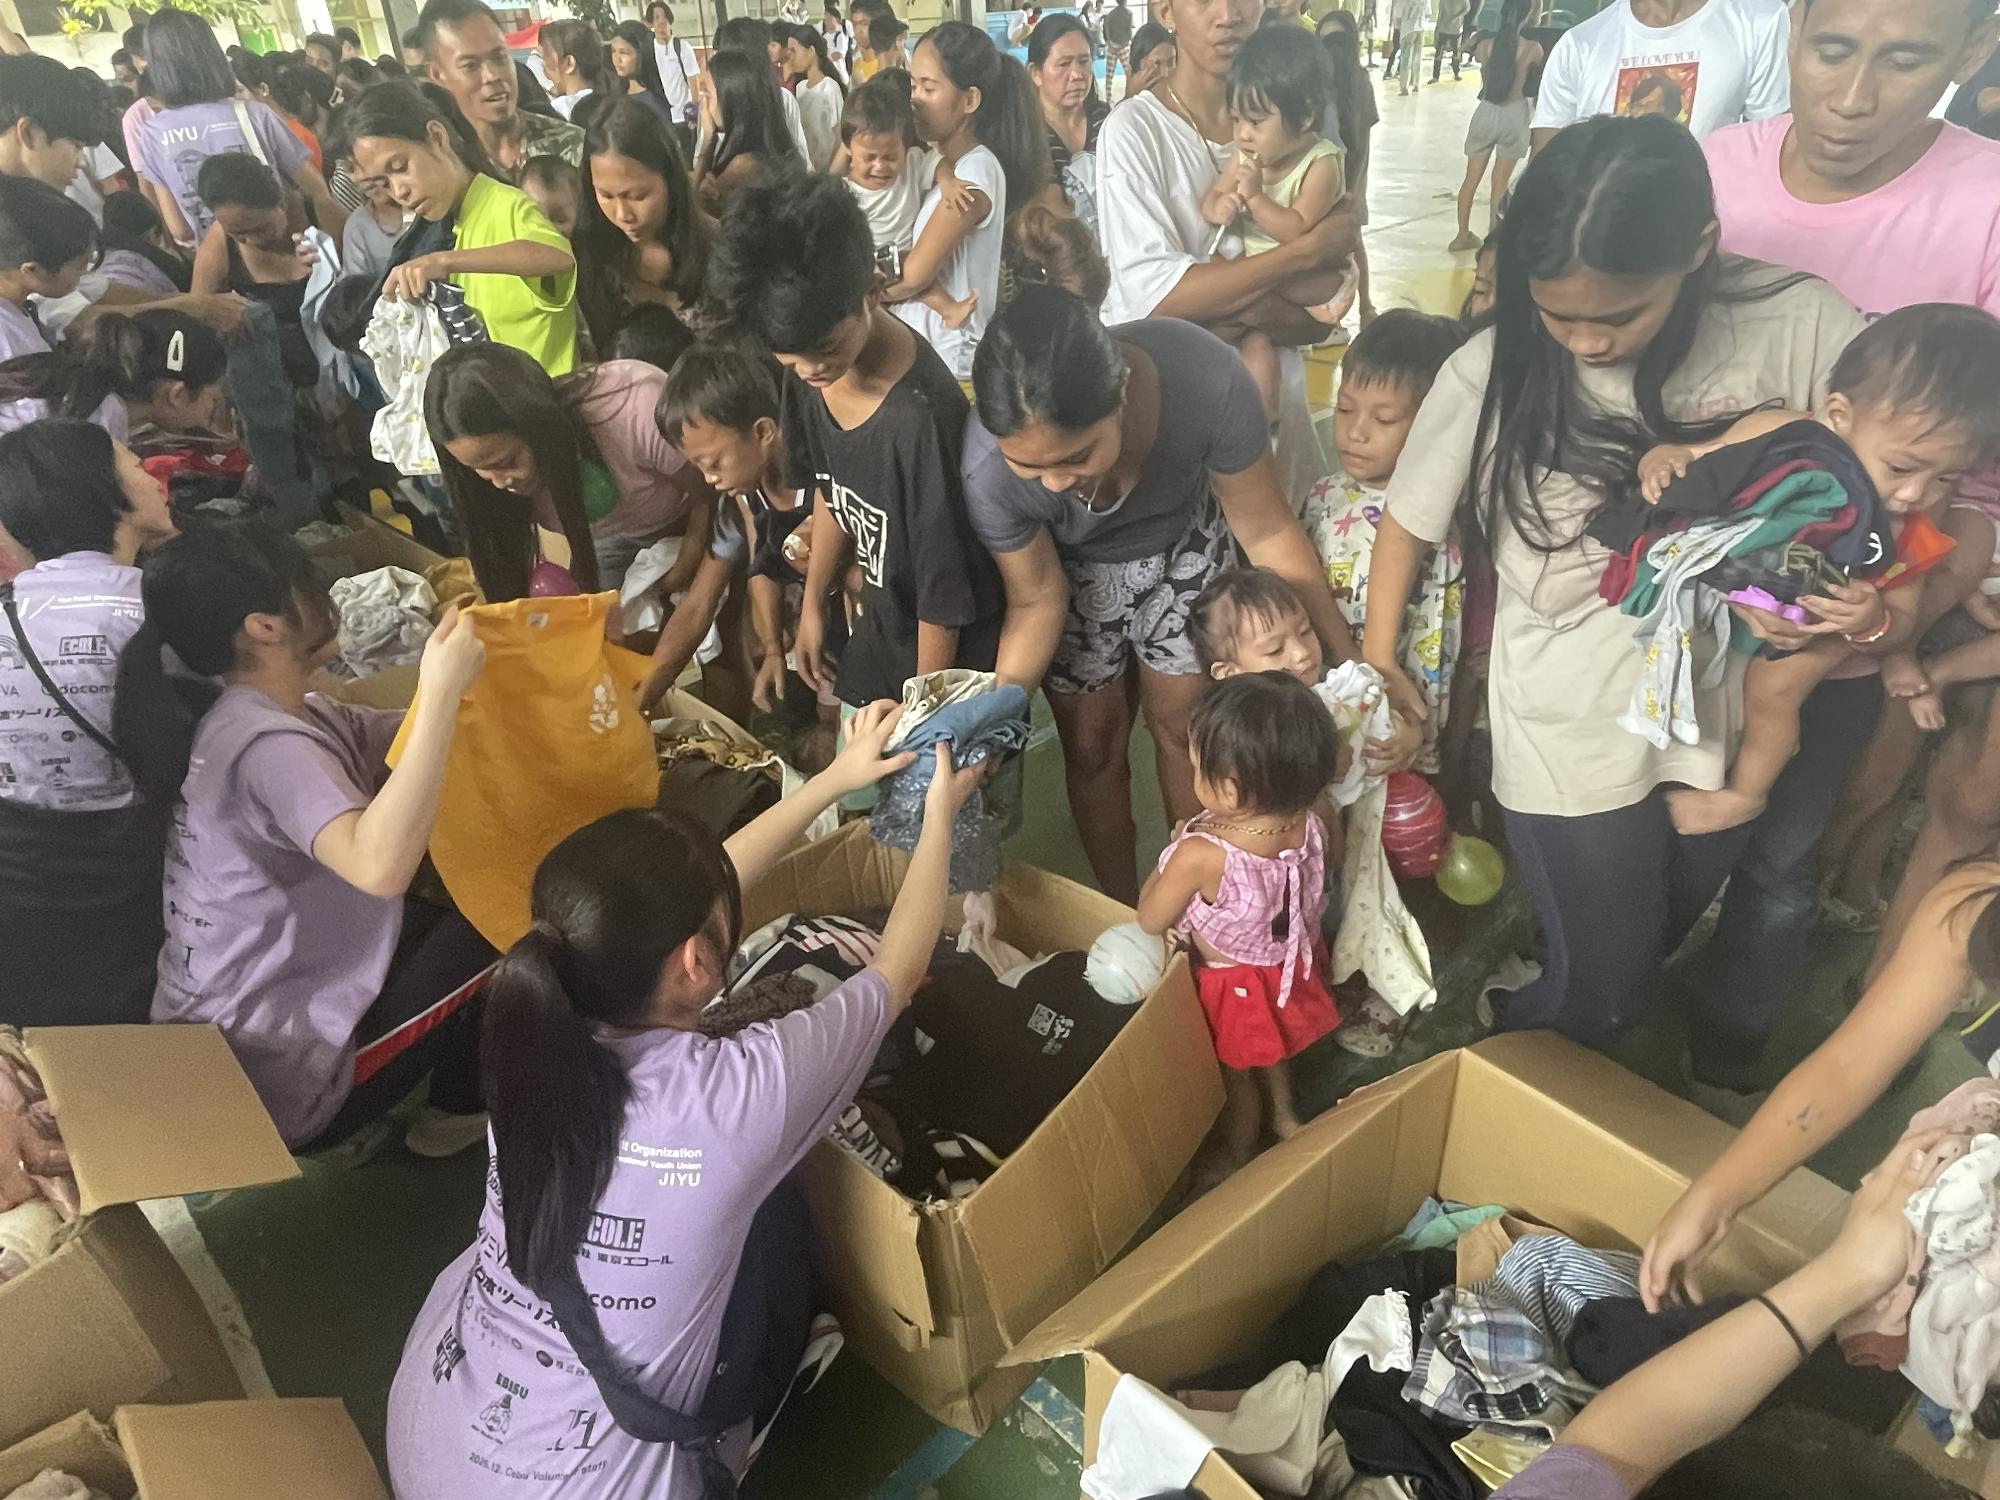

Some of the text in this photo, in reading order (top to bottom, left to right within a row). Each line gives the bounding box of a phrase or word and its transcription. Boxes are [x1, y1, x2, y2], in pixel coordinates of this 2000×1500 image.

[161, 126, 198, 146] JIYU
[0, 685, 20, 697] VA
[630, 1142, 703, 1159] Organization
[658, 1172, 701, 1187] JIYU
[587, 1214, 643, 1250] COLE
[589, 1293, 657, 1310] como
[495, 1372, 529, 1400] EBISU
